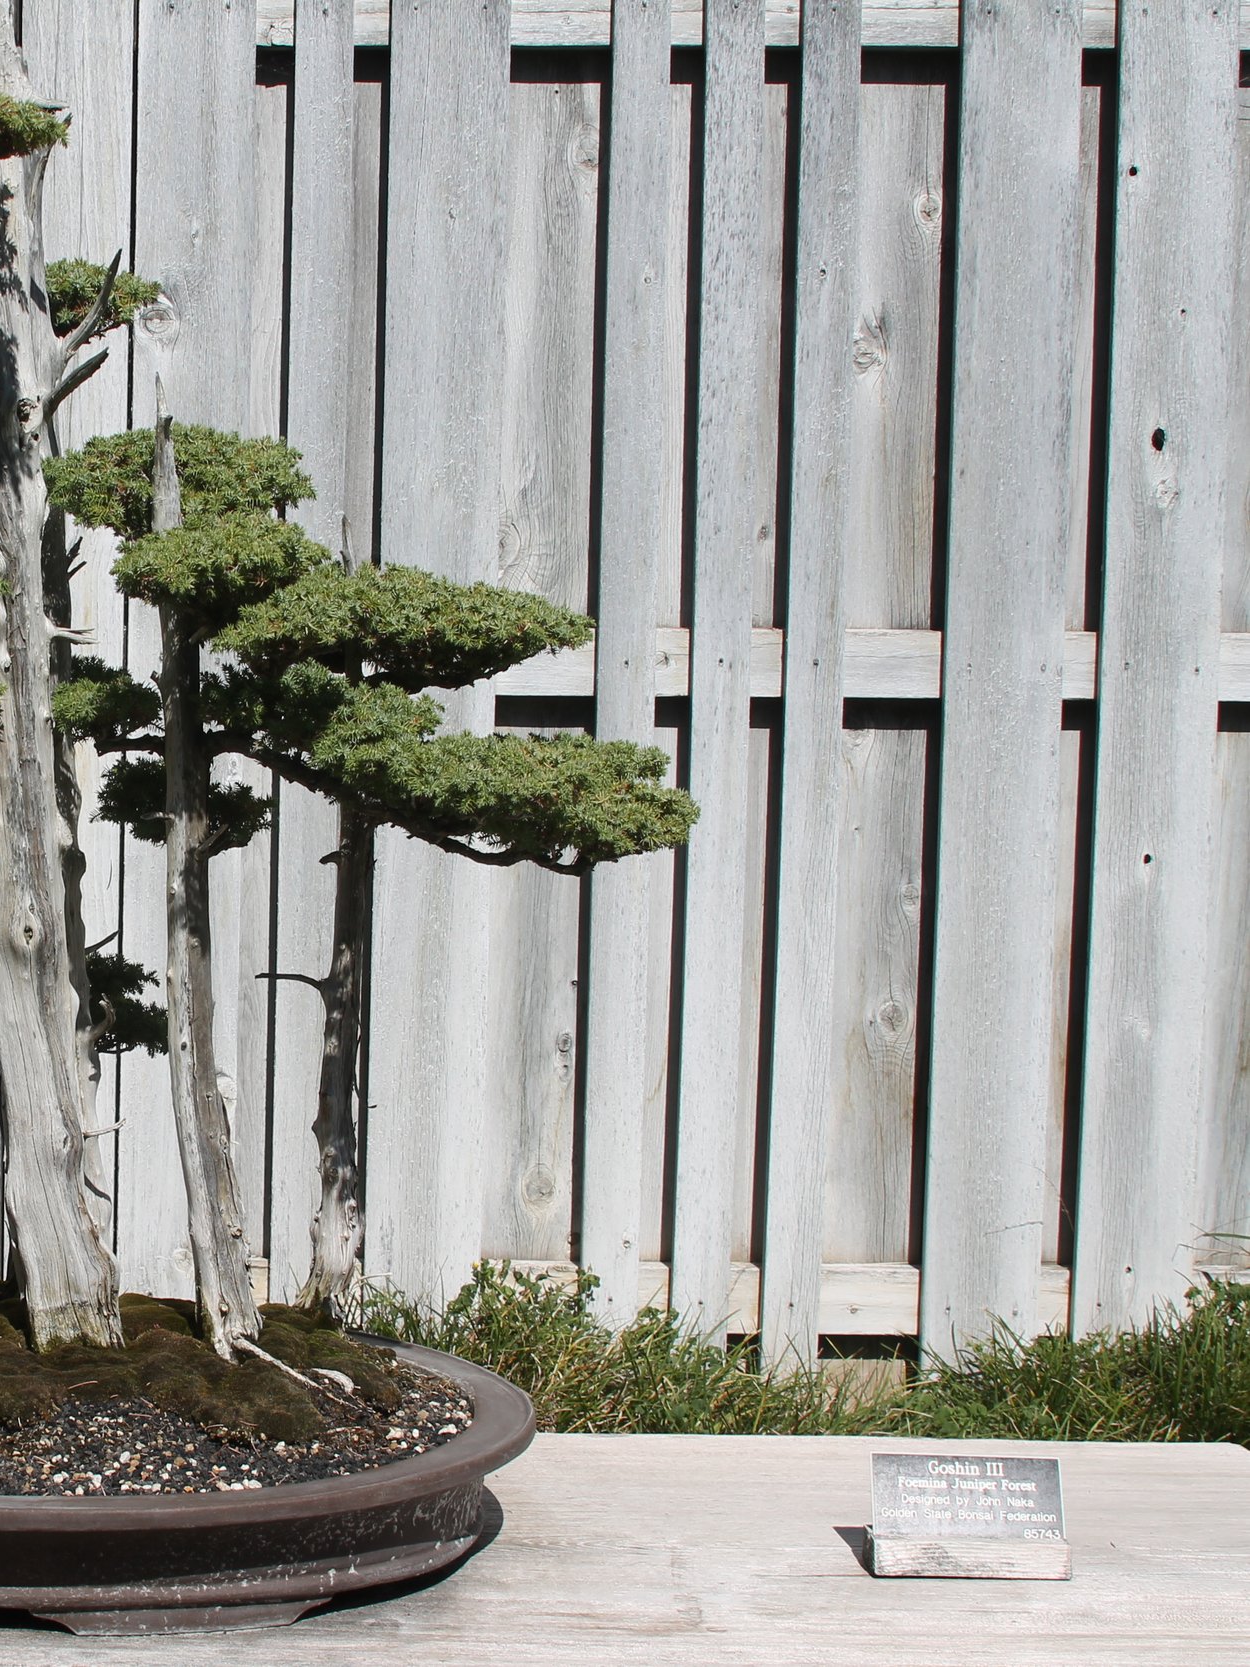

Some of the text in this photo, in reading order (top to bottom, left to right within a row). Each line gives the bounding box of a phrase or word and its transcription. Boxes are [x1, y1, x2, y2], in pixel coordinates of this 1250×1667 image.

[928, 1460, 1005, 1476] Goshin III
[898, 1476, 1037, 1492] Foemina Juniper Forest
[901, 1493, 1034, 1507] Designed by John Naka
[881, 1507, 1057, 1522] Golden State Bonsai Federation
[1023, 1528, 1061, 1539] 85743
